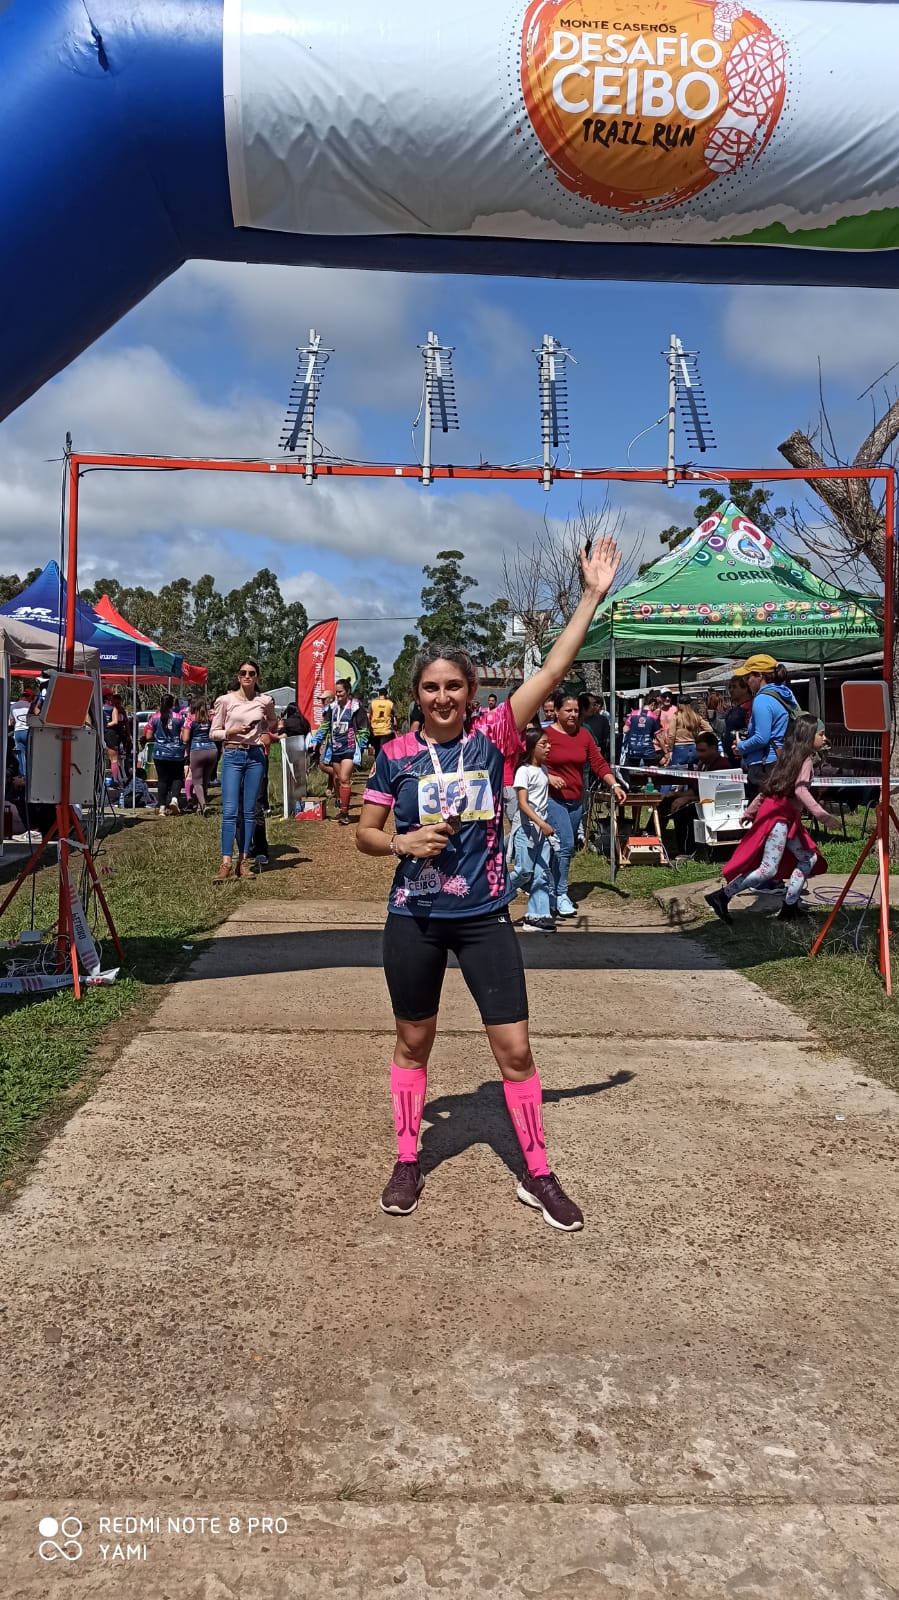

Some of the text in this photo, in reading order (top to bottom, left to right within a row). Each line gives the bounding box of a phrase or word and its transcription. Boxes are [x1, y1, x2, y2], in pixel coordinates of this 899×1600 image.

[560, 19, 677, 34] MONTE CASEROS
[552, 31, 723, 69] DESAFÍO
[552, 64, 720, 120] CEIBO
[582, 118, 696, 152] TRAIL RUN
[695, 628, 747, 639] Ministerio
[750, 627, 762, 638] de
[764, 624, 829, 638] Coordinación
[830, 627, 837, 638] y
[421, 778, 488, 815] 367
[408, 880, 436, 891] CEIBO
